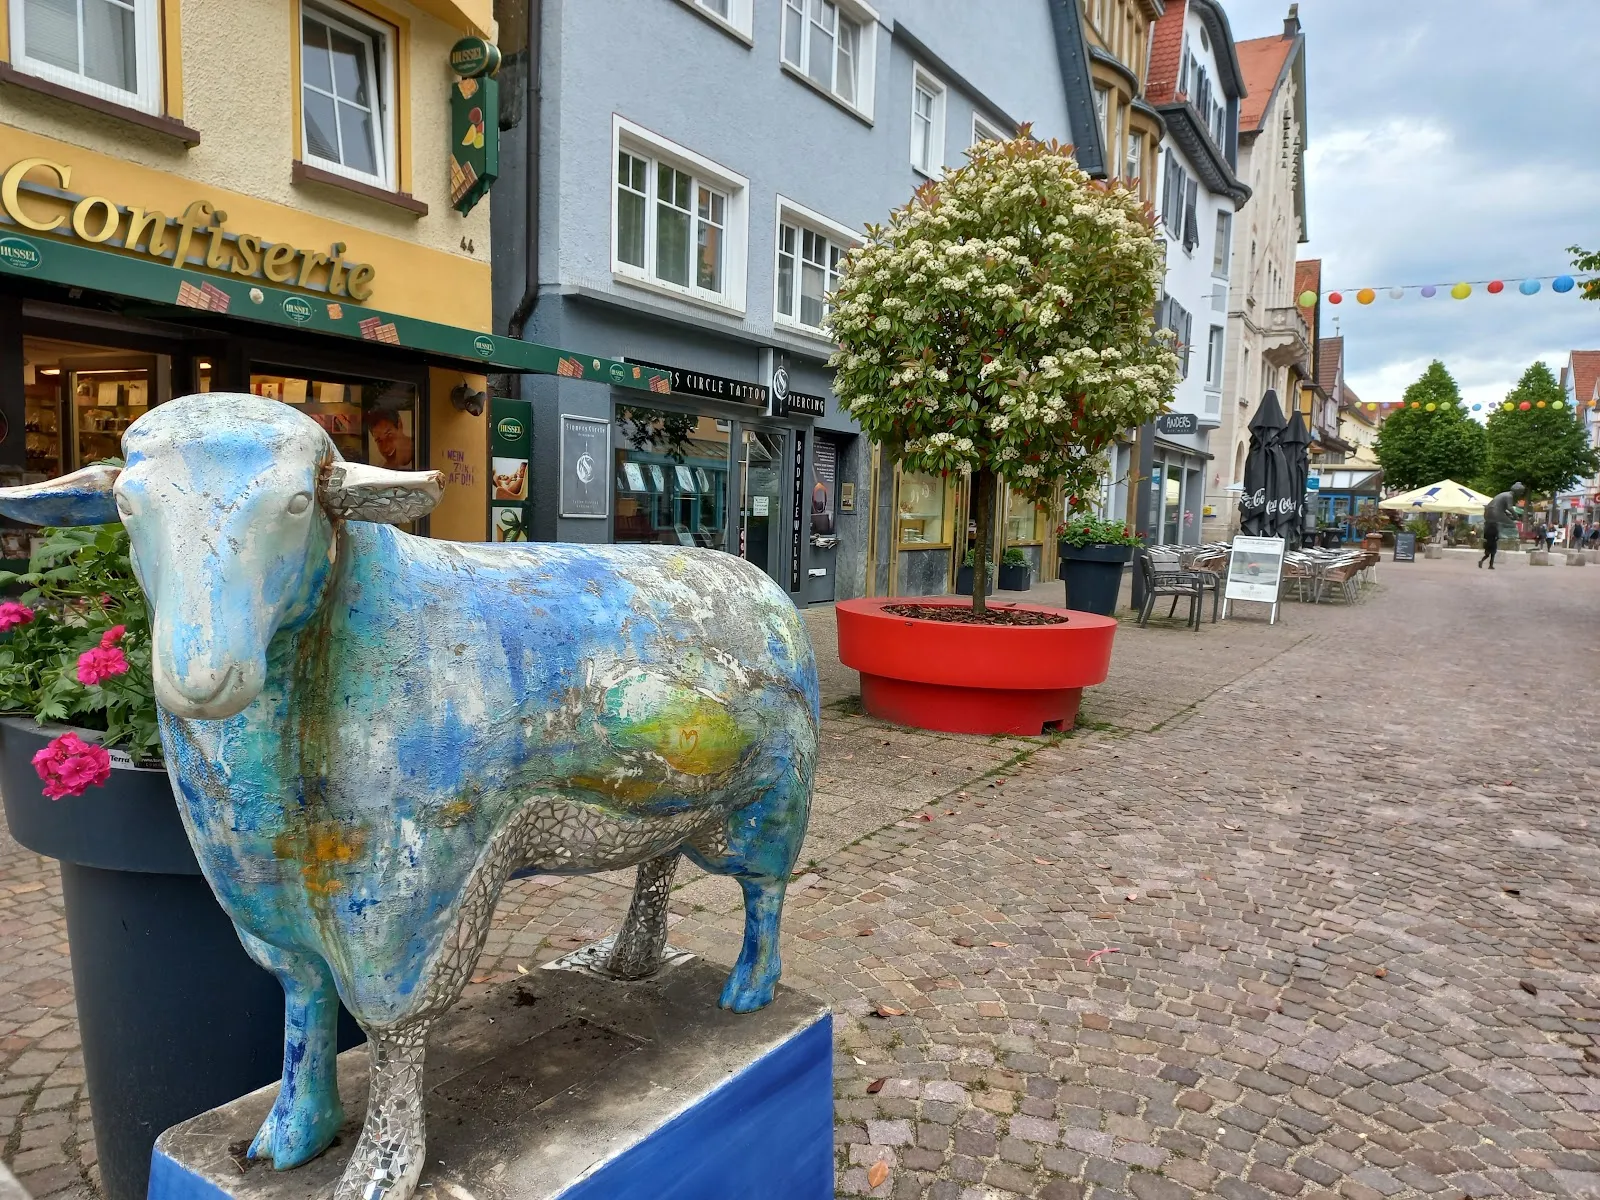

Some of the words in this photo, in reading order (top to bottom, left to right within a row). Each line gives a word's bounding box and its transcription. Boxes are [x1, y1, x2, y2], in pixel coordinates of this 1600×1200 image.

[452, 47, 483, 64] HUSSEL
[1, 157, 376, 301] Confiserie
[0, 245, 38, 262] HUSSEL
[460, 235, 475, 254] 44
[286, 303, 311, 316] HUSSEL
[686, 373, 724, 393] CIRCLE
[729, 382, 766, 401] TATTOO
[787, 394, 824, 413] PIERCING
[500, 425, 522, 434] HUSSEL
